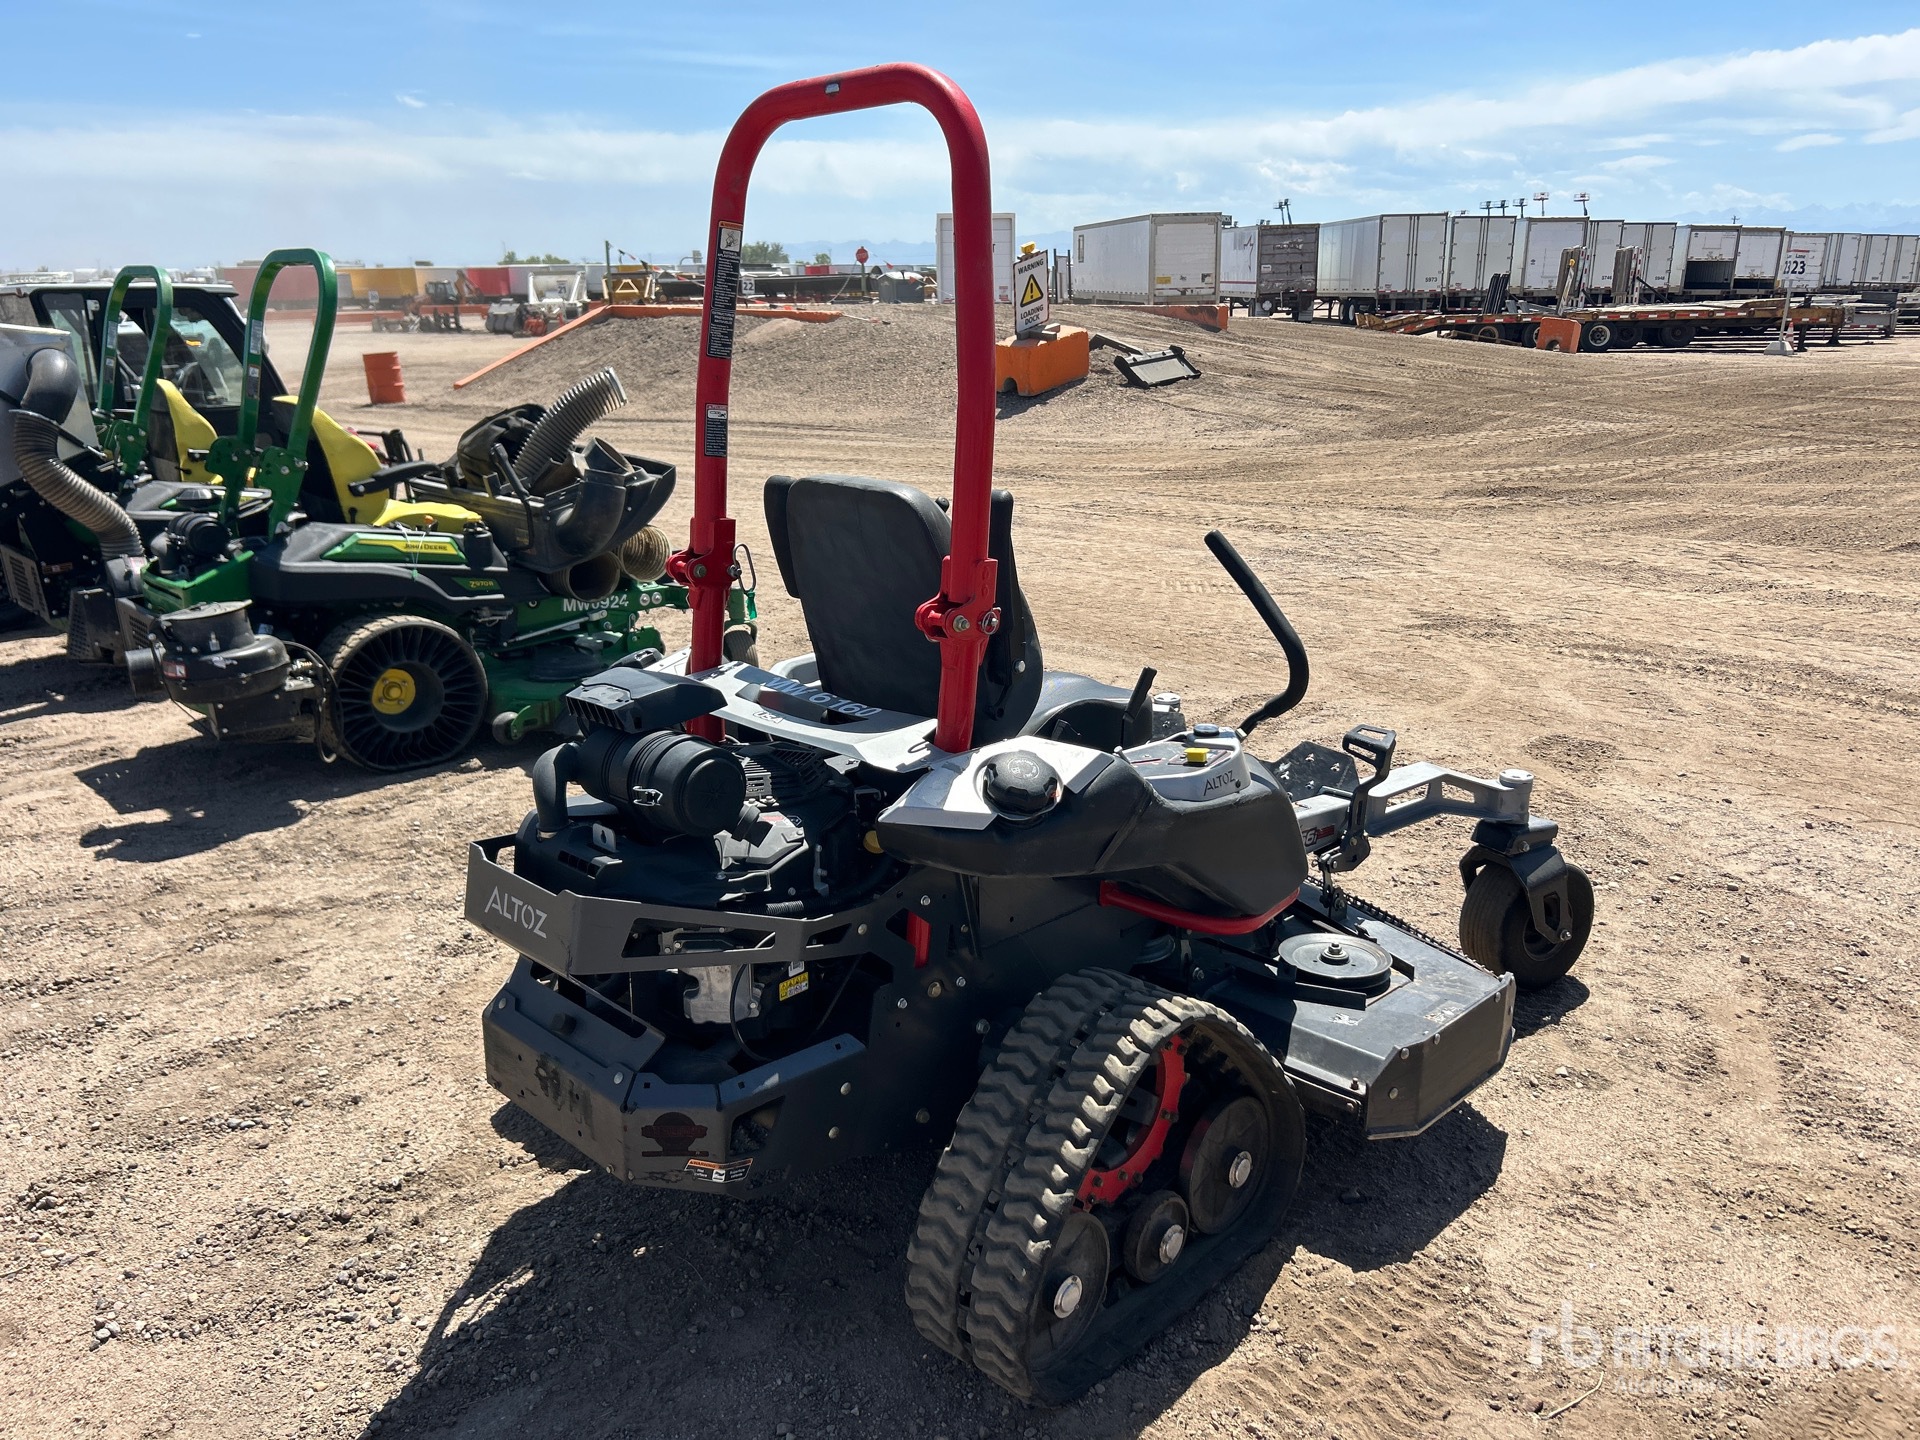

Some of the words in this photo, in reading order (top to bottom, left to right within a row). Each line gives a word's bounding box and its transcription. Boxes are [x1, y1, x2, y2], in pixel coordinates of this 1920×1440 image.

[1018, 258, 1044, 275] WARNING
[557, 285, 567, 294] 21
[743, 282, 754, 291] 22
[1020, 304, 1044, 320] LOADING
[1025, 313, 1040, 325] DOCK
[809, 692, 882, 717] 6160
[754, 711, 784, 724] USA
[1203, 770, 1236, 796] ALTOZ
[484, 886, 548, 939] ALTOZ
